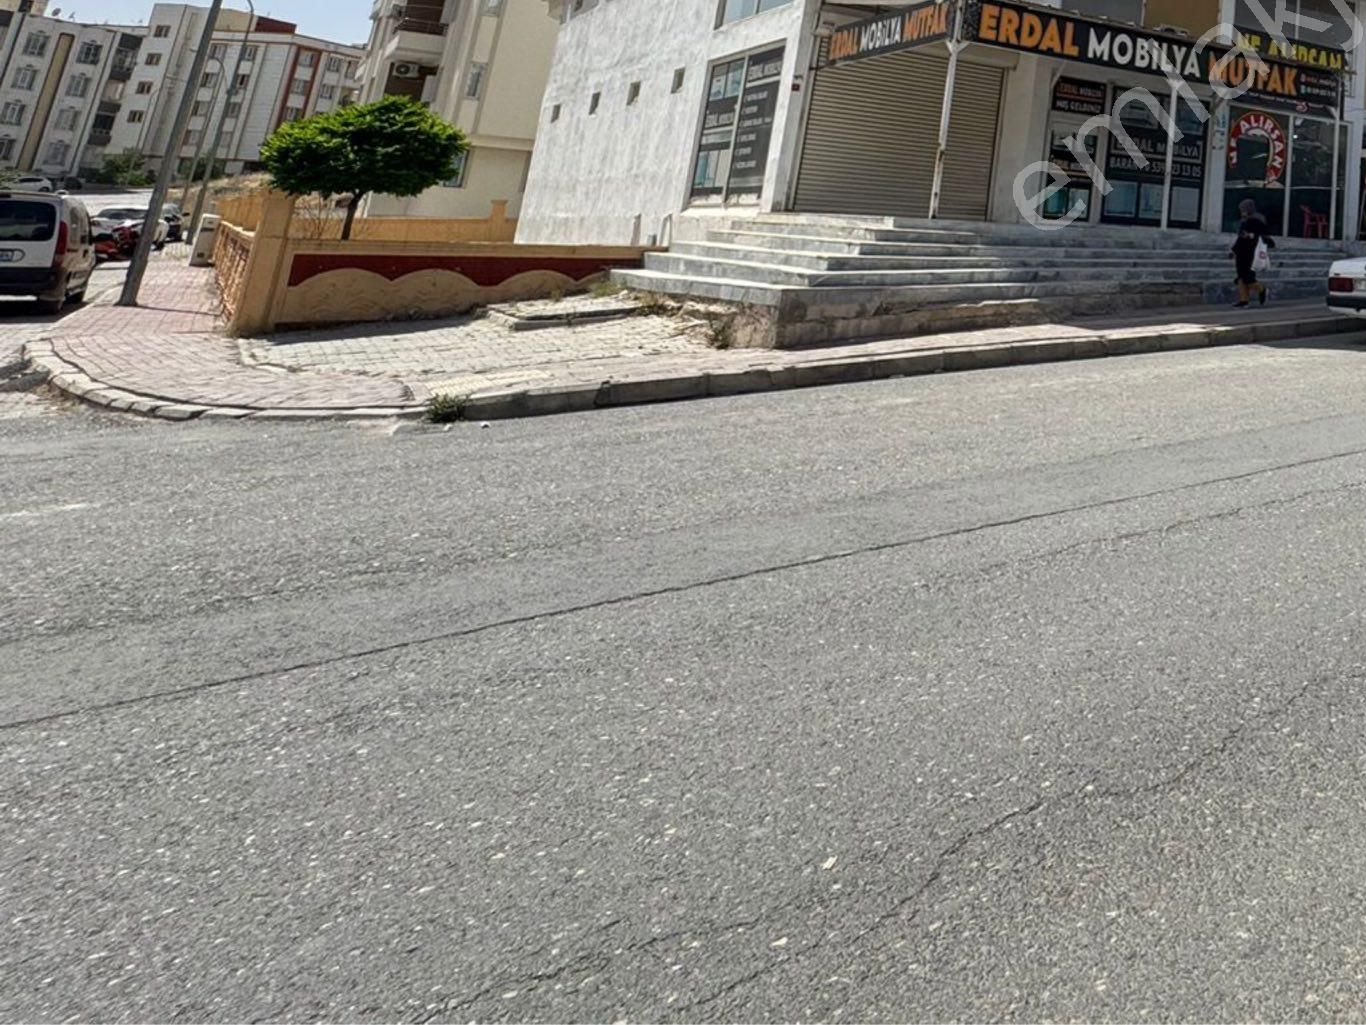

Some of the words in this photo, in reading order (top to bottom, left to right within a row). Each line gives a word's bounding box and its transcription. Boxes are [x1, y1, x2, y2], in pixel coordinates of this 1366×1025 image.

[829, 29, 860, 61] ERDAL
[860, 15, 902, 53] MOBİLYA
[903, 1, 949, 42] MUTFAK
[979, 3, 1081, 57] ERDAL
[1087, 27, 1201, 78] MOBİLYA
[1240, 115, 1285, 169] ALIRSAN
